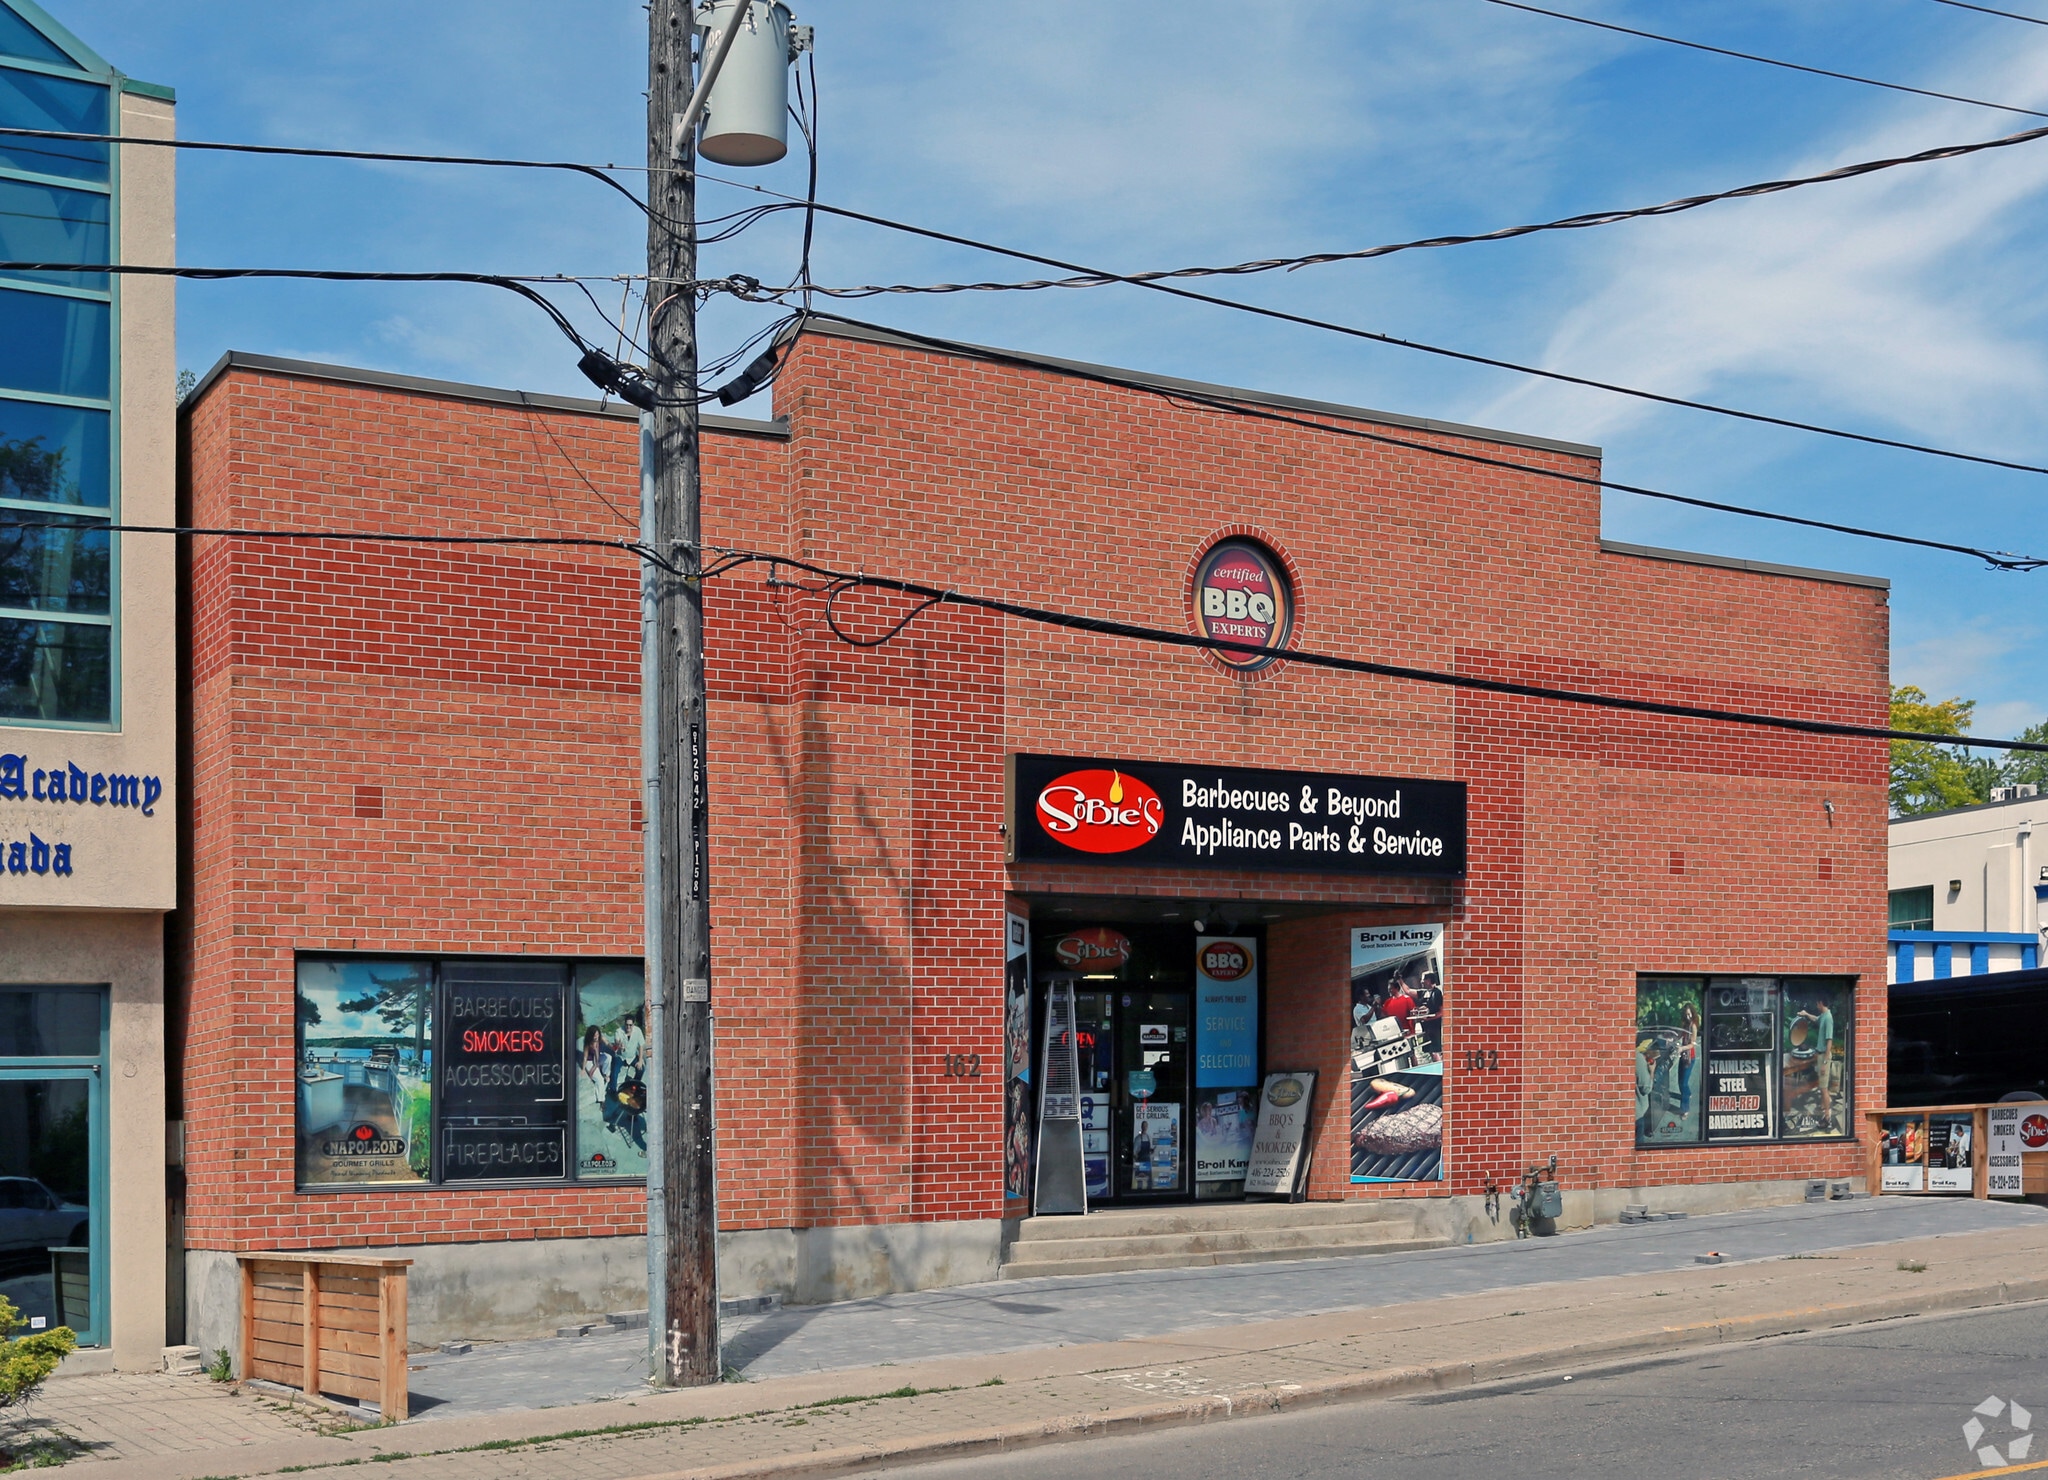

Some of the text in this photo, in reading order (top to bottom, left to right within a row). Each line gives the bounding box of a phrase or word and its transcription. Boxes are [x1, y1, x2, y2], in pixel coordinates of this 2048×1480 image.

[1213, 567, 1265, 583] certified
[1204, 586, 1276, 625] BBQ
[1211, 621, 1267, 639] EXPERTS
[0, 753, 162, 816] Academy
[1182, 778, 1400, 826] Barbecues & Beyond
[1181, 817, 1443, 857] Appliance Parts & Service
[0, 832, 73, 877] ada
[1360, 928, 1433, 942] Broil King
[1376, 941, 1403, 949] Barbecues
[1206, 951, 1244, 969] BBQ
[1204, 995, 1247, 1004] ALWAYS THE BEST
[452, 996, 554, 1019] BARBECUES
[1206, 1016, 1246, 1031] SERVICE
[463, 1029, 545, 1053] SMOKERS
[944, 1053, 981, 1077] 162
[1200, 1054, 1251, 1069] SELECTION
[1466, 1050, 1498, 1071] 162
[1709, 1059, 1760, 1075] STAINLESS
[445, 1063, 562, 1087] ACCESSORIES
[1719, 1078, 1747, 1093] STEEL
[1147, 1105, 1169, 1113] SERIOUS
[1709, 1094, 1761, 1112] INFRA-RED
[1136, 1112, 1146, 1120] GET
[1269, 1113, 1294, 1128] BBQ'S
[1709, 1114, 1765, 1130] BARBECUES
[1991, 1108, 2018, 1121] BARBECUES
[1993, 1124, 2016, 1136] SMOKERS
[329, 1140, 399, 1155] NAPOLEON
[446, 1142, 559, 1166] FIREPLACES
[1255, 1141, 1297, 1154] SMOKERS
[333, 1160, 367, 1168] GOURMET
[583, 1160, 614, 1168] NAPOLEON
[1197, 1160, 1226, 1170] Broil
[1989, 1155, 2020, 1168] ACCESSORIES
[1251, 1167, 1290, 1178] 416-224-2526
[1989, 1175, 2020, 1190] 416-224-2526
